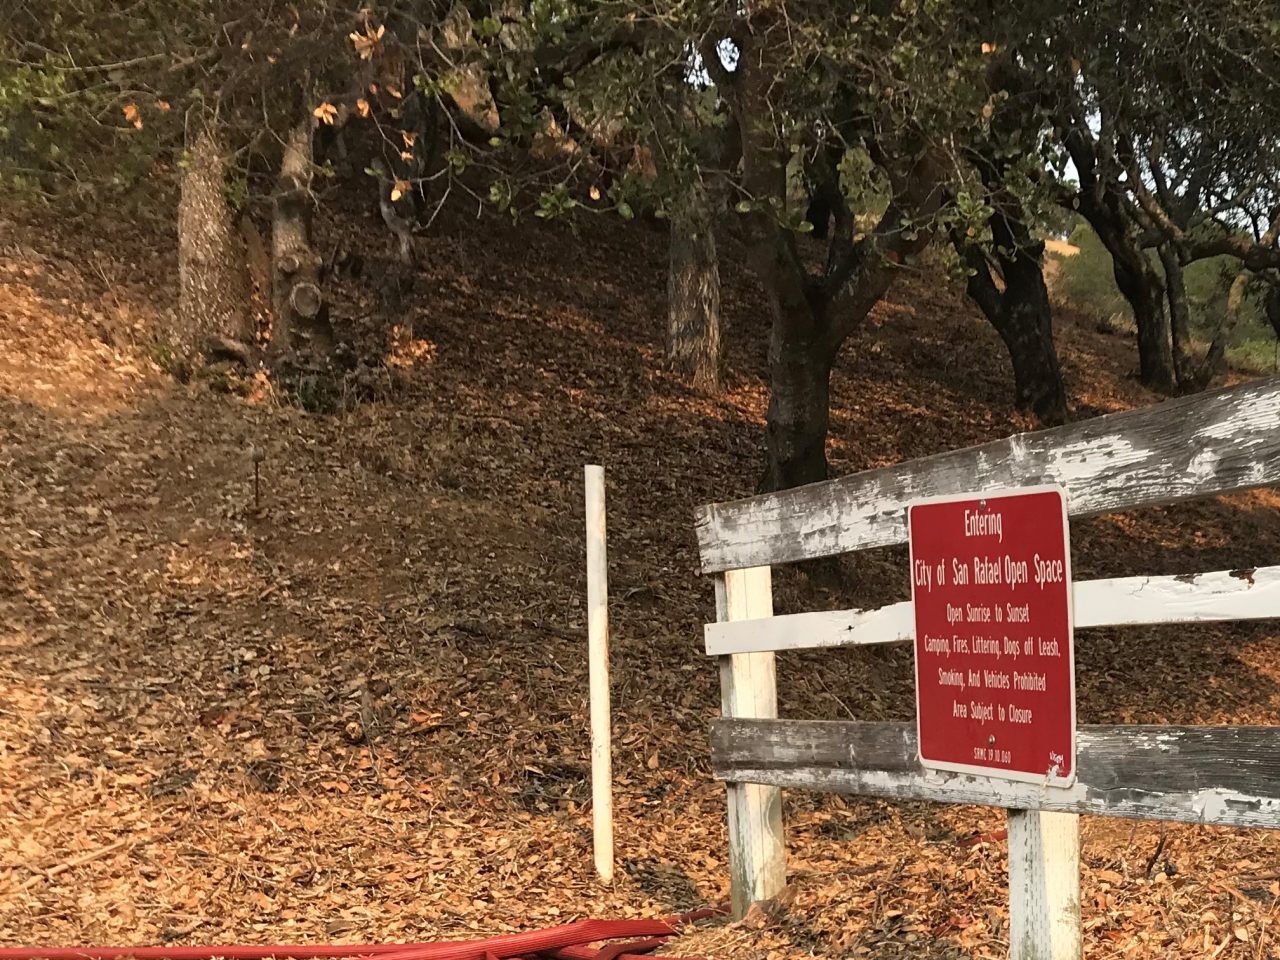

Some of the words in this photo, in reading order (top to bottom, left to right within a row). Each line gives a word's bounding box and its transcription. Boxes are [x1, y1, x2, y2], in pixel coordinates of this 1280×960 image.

[964, 508, 1003, 544] Entering
[914, 558, 932, 593] City
[936, 558, 946, 586] of
[952, 556, 969, 587] San
[974, 555, 1002, 585] Rafael
[1004, 554, 1028, 591] Open
[1033, 552, 1063, 591] Space
[946, 602, 963, 627] Open
[966, 602, 991, 623] Sunrise
[994, 603, 1003, 623] to
[1006, 602, 1030, 623] Sunset
[924, 634, 951, 659] Camping,
[1003, 635, 1021, 661] Dogs
[1024, 636, 1034, 656] off
[968, 668, 981, 688] And
[983, 669, 1011, 690] Vehicles
[1013, 670, 1047, 692] Prohibited
[952, 699, 968, 719] Area
[970, 700, 994, 726] Subject
[997, 703, 1006, 722] to
[1008, 703, 1033, 725] Closure
